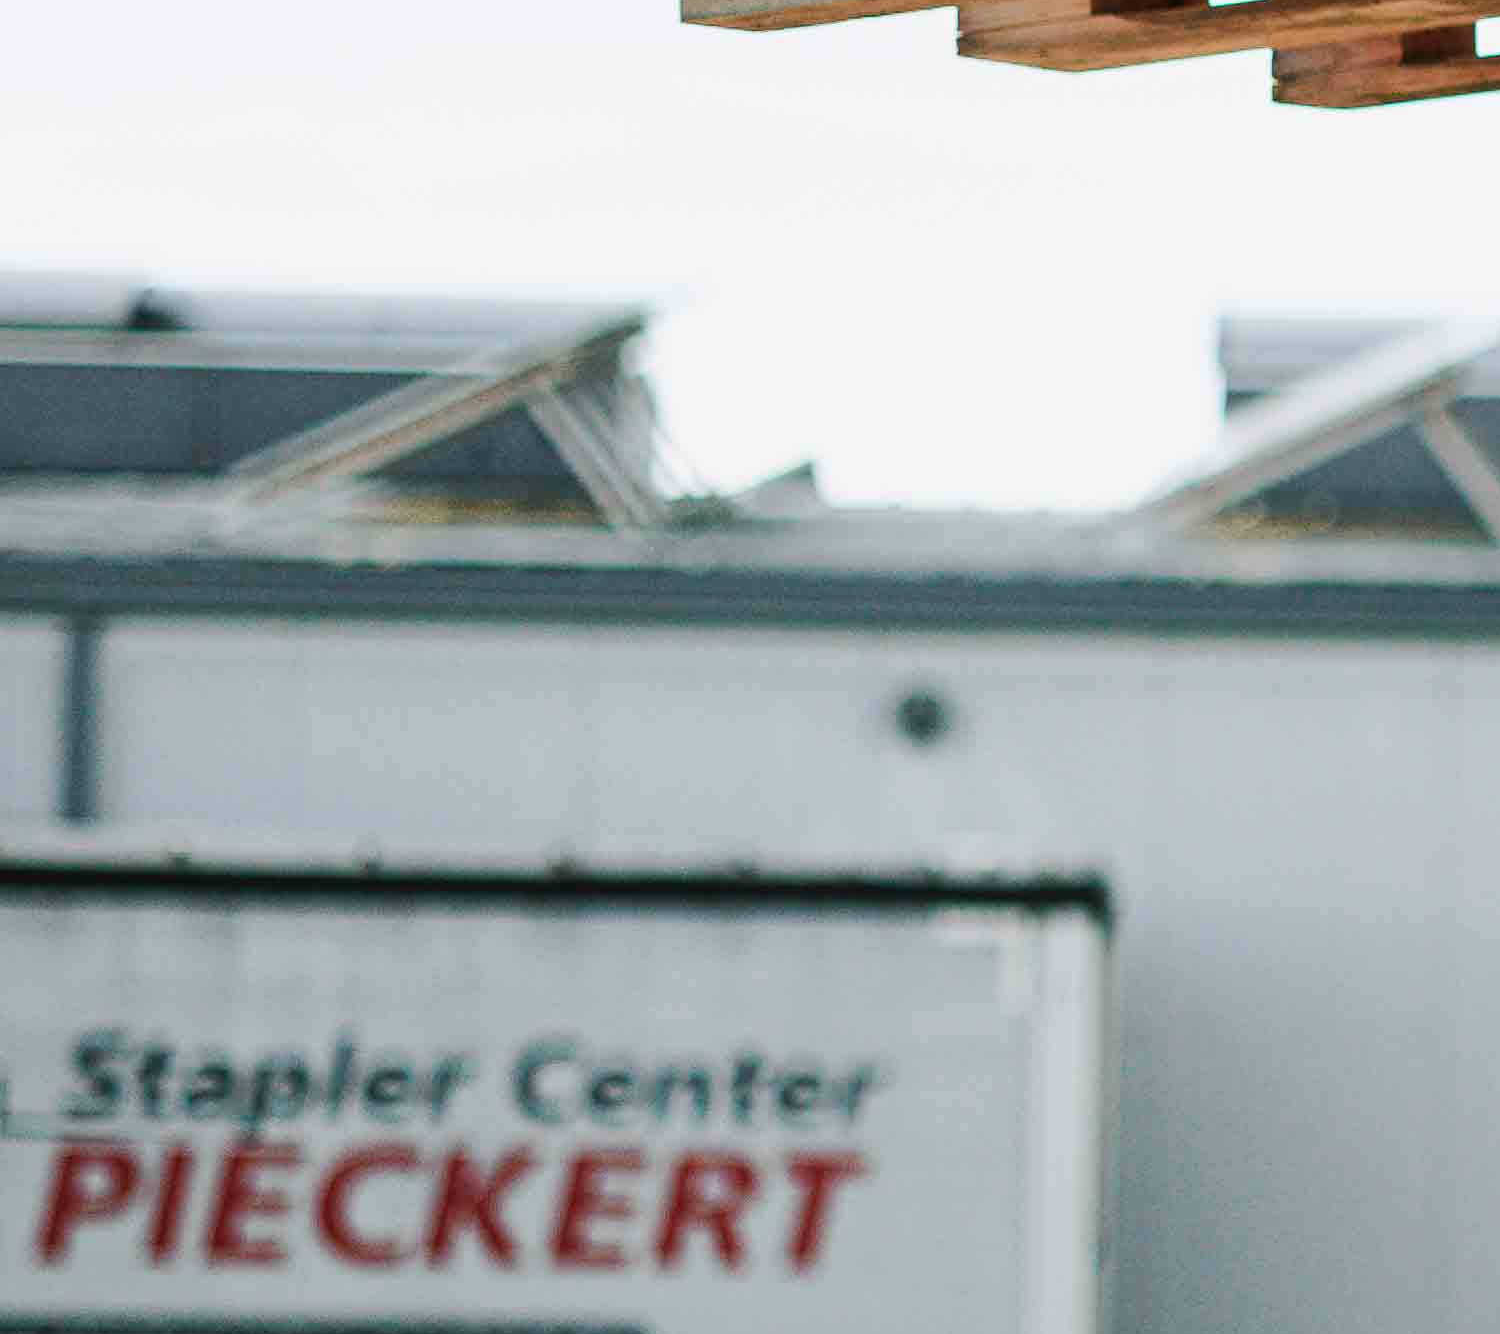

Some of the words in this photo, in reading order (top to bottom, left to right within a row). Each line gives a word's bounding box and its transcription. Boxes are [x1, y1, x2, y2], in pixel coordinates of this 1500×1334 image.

[68, 1027, 474, 1145] Stapler
[514, 1033, 877, 1130] Center
[32, 1135, 871, 1273] PIECKERT
